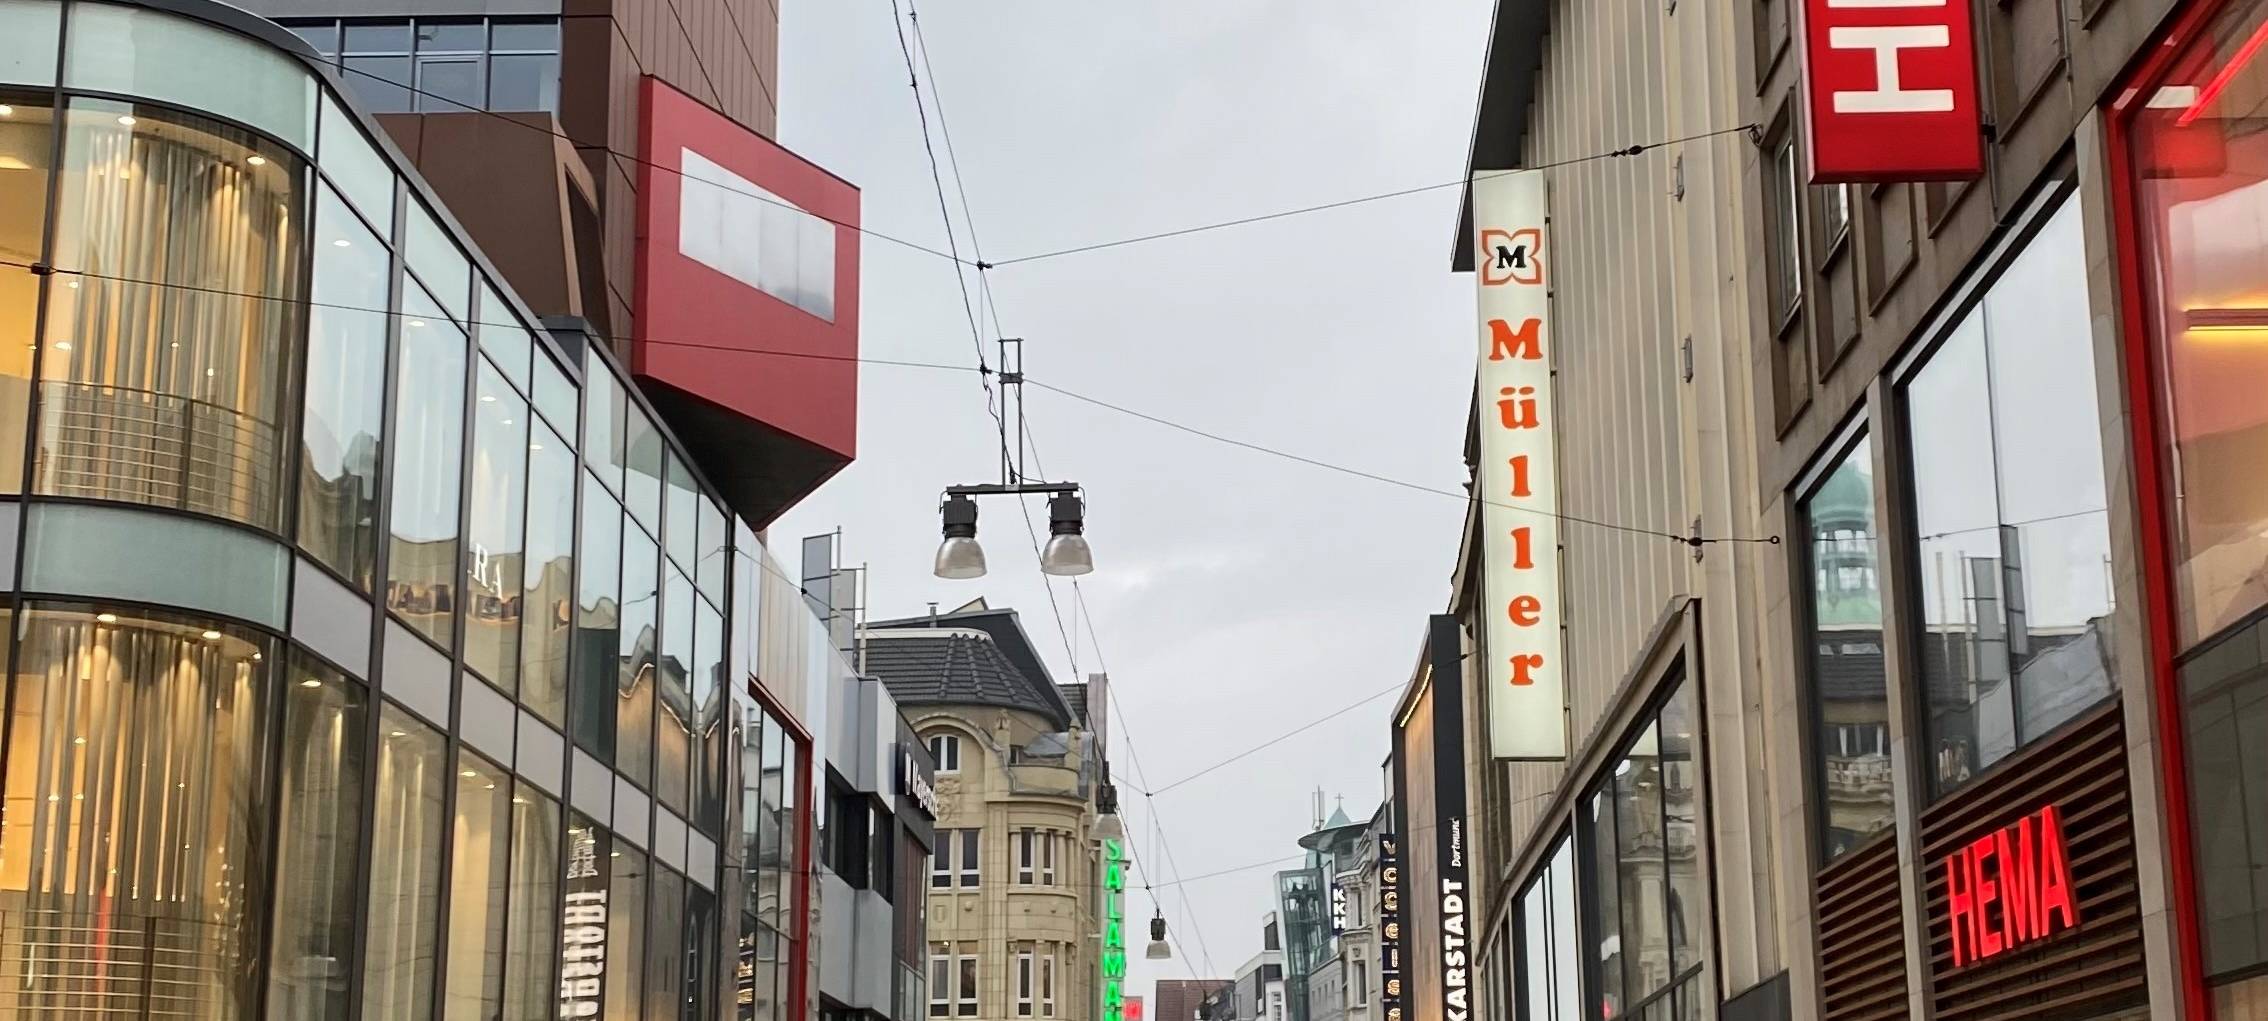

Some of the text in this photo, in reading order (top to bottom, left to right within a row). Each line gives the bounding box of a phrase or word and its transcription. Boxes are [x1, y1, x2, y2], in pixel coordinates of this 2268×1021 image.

[1496, 245, 1527, 269] M
[1487, 318, 1543, 686] Müller
[1333, 888, 1346, 930] KKH
[1946, 805, 2075, 967] HEMA
